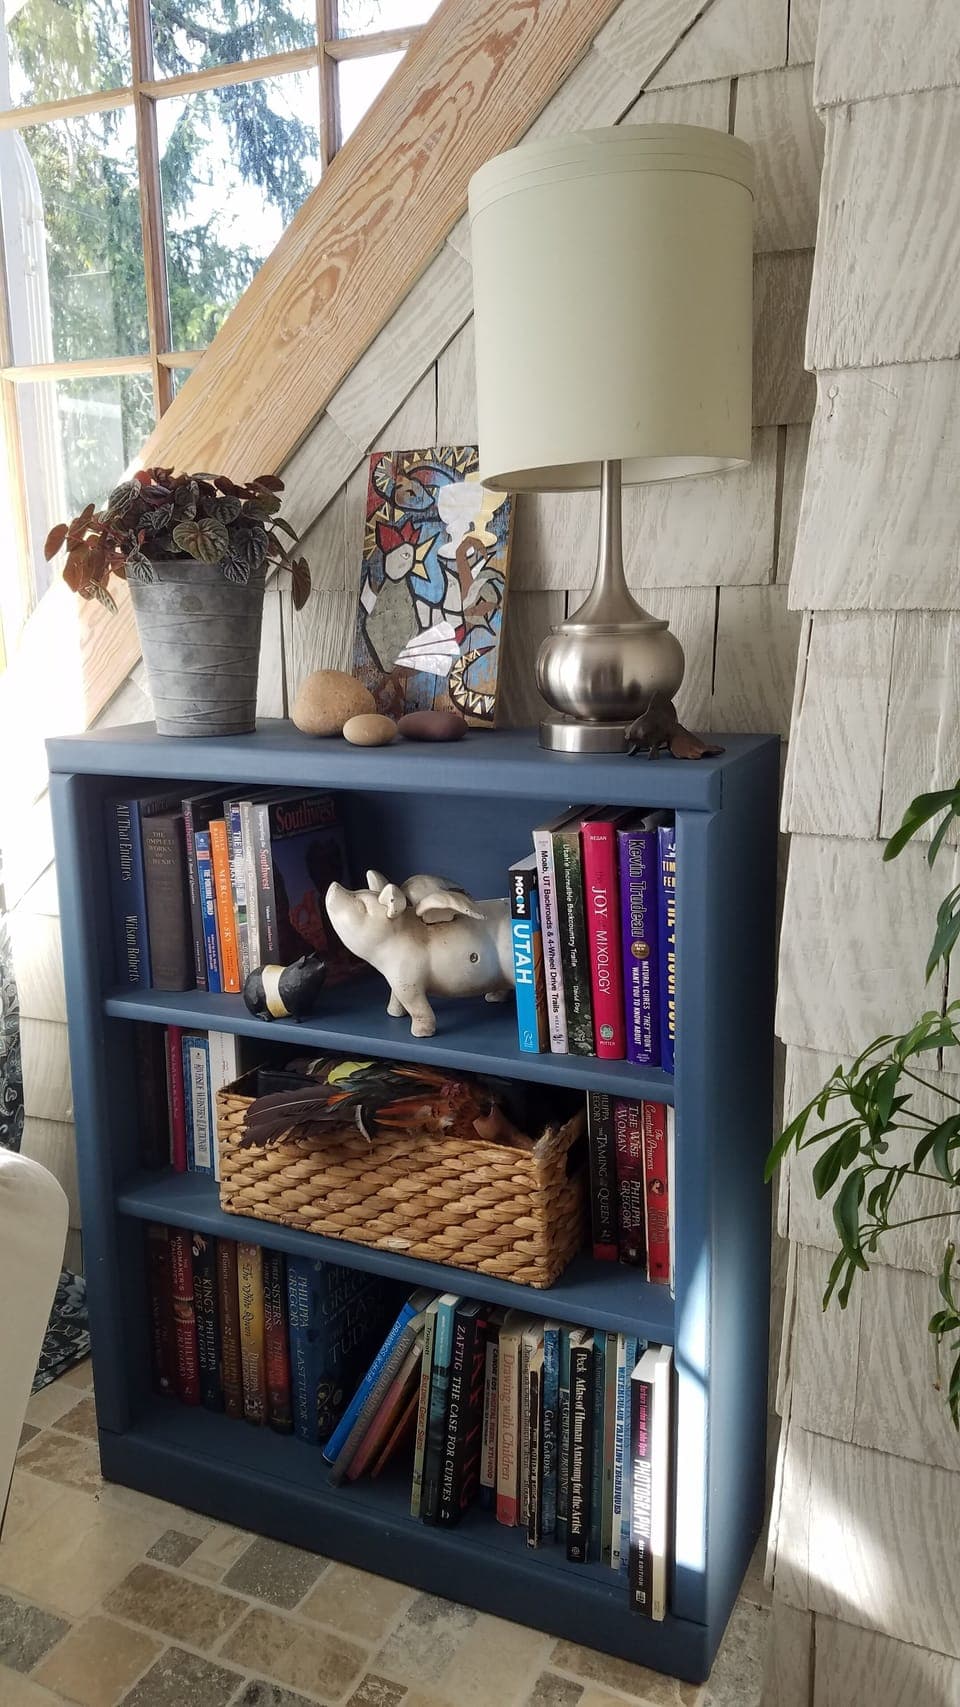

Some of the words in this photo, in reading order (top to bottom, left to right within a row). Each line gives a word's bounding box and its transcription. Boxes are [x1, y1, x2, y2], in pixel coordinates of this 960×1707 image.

[116, 804, 130, 817] All
[275, 799, 336, 833] Southwest
[118, 820, 131, 840] That
[184, 811, 194, 856] Sunbeams
[120, 843, 132, 881] Endures
[260, 849, 271, 890] Southwest
[540, 851, 550, 874] Moab,
[563, 844, 572, 866] Utah's
[628, 840, 646, 878] Kevin
[514, 876, 526, 914] MOON
[542, 876, 550, 886] UT
[564, 868, 575, 902] Incredible
[543, 889, 554, 930] Backroads
[592, 886, 608, 918] JOY
[630, 882, 646, 938] Trudeau
[125, 915, 138, 945] Wilson
[566, 903, 577, 947] Backcountry
[128, 948, 140, 982] Roberts
[512, 924, 533, 984] UTAH
[548, 938, 556, 970] 4-Wheel
[570, 948, 579, 968] Trails
[596, 930, 610, 994] MIXOLOGY
[550, 972, 558, 991] Drive
[632, 967, 640, 983] WANT
[642, 961, 650, 987] NATURAL
[552, 994, 560, 1013] Trails
[572, 986, 580, 1002] David
[632, 985, 640, 997] YOU
[633, 998, 640, 1006] TO
[573, 1002, 581, 1014] Day
[633, 1006, 641, 1024] KNOW
[634, 1026, 642, 1045] ABOUT
[644, 1034, 652, 1053] DON'T
[194, 1063, 205, 1090] RIVERSIDE
[617, 1109, 628, 1153] WOMAN
[629, 1106, 639, 1128] THE
[644, 1104, 656, 1137] Constant
[197, 1124, 208, 1152] DICTIONARY
[630, 1130, 641, 1158] WISE
[596, 1136, 609, 1178] TAMING
[646, 1140, 658, 1170] Princess
[598, 1187, 611, 1225] QUEEN
[620, 1180, 632, 1231] GREGORY
[630, 1180, 641, 1227] PHILIPPA
[176, 1236, 185, 1291] KINGMAKER'S
[242, 1264, 253, 1280] The
[193, 1275, 203, 1311] CURSE
[202, 1279, 214, 1313] KING'S
[242, 1284, 254, 1308] White
[262, 1286, 272, 1331] QUEENS
[272, 1282, 282, 1326] SISTERS
[288, 1268, 298, 1328] GREGORY
[297, 1276, 309, 1328] PHILIPPA
[243, 1312, 255, 1337] Queen
[377, 1321, 402, 1357] DRAWINGS
[424, 1326, 432, 1355] Truscott
[176, 1329, 186, 1376] GREGORY
[184, 1330, 194, 1380] PHILIPPA
[196, 1316, 206, 1370] GREGORY
[205, 1320, 216, 1371] PHILIPPA
[385, 1336, 410, 1370] NATIONAL
[454, 1324, 466, 1371] ZAFTIG
[250, 1352, 259, 1392] PHILIPPA
[296, 1349, 306, 1378] LAST
[501, 1354, 514, 1402] Drawing
[576, 1352, 588, 1374] Peck
[298, 1378, 308, 1421] TUDOR
[450, 1376, 462, 1400] THE
[576, 1376, 586, 1400] Atlas
[638, 1384, 648, 1404] Barbara
[448, 1403, 460, 1432] CASE
[502, 1404, 514, 1430] with
[574, 1400, 586, 1411] of
[639, 1404, 648, 1422] London
[544, 1410, 554, 1440] GAIA'S
[574, 1411, 586, 1442] Human
[638, 1430, 648, 1442] John
[446, 1435, 457, 1456] FOR
[502, 1431, 514, 1480] Children
[544, 1441, 555, 1476] GARDEN
[615, 1424, 624, 1462] PAINTING
[561, 1452, 570, 1493] DRAWING
[571, 1444, 584, 1480] Anatomy
[441, 1459, 455, 1502] CURVES
[572, 1480, 584, 1494] for
[614, 1464, 623, 1515] TECHNIQUES
[572, 1495, 582, 1510] the
[633, 1459, 652, 1539] PHOTOGRAPHY
[572, 1510, 582, 1535] Artist
